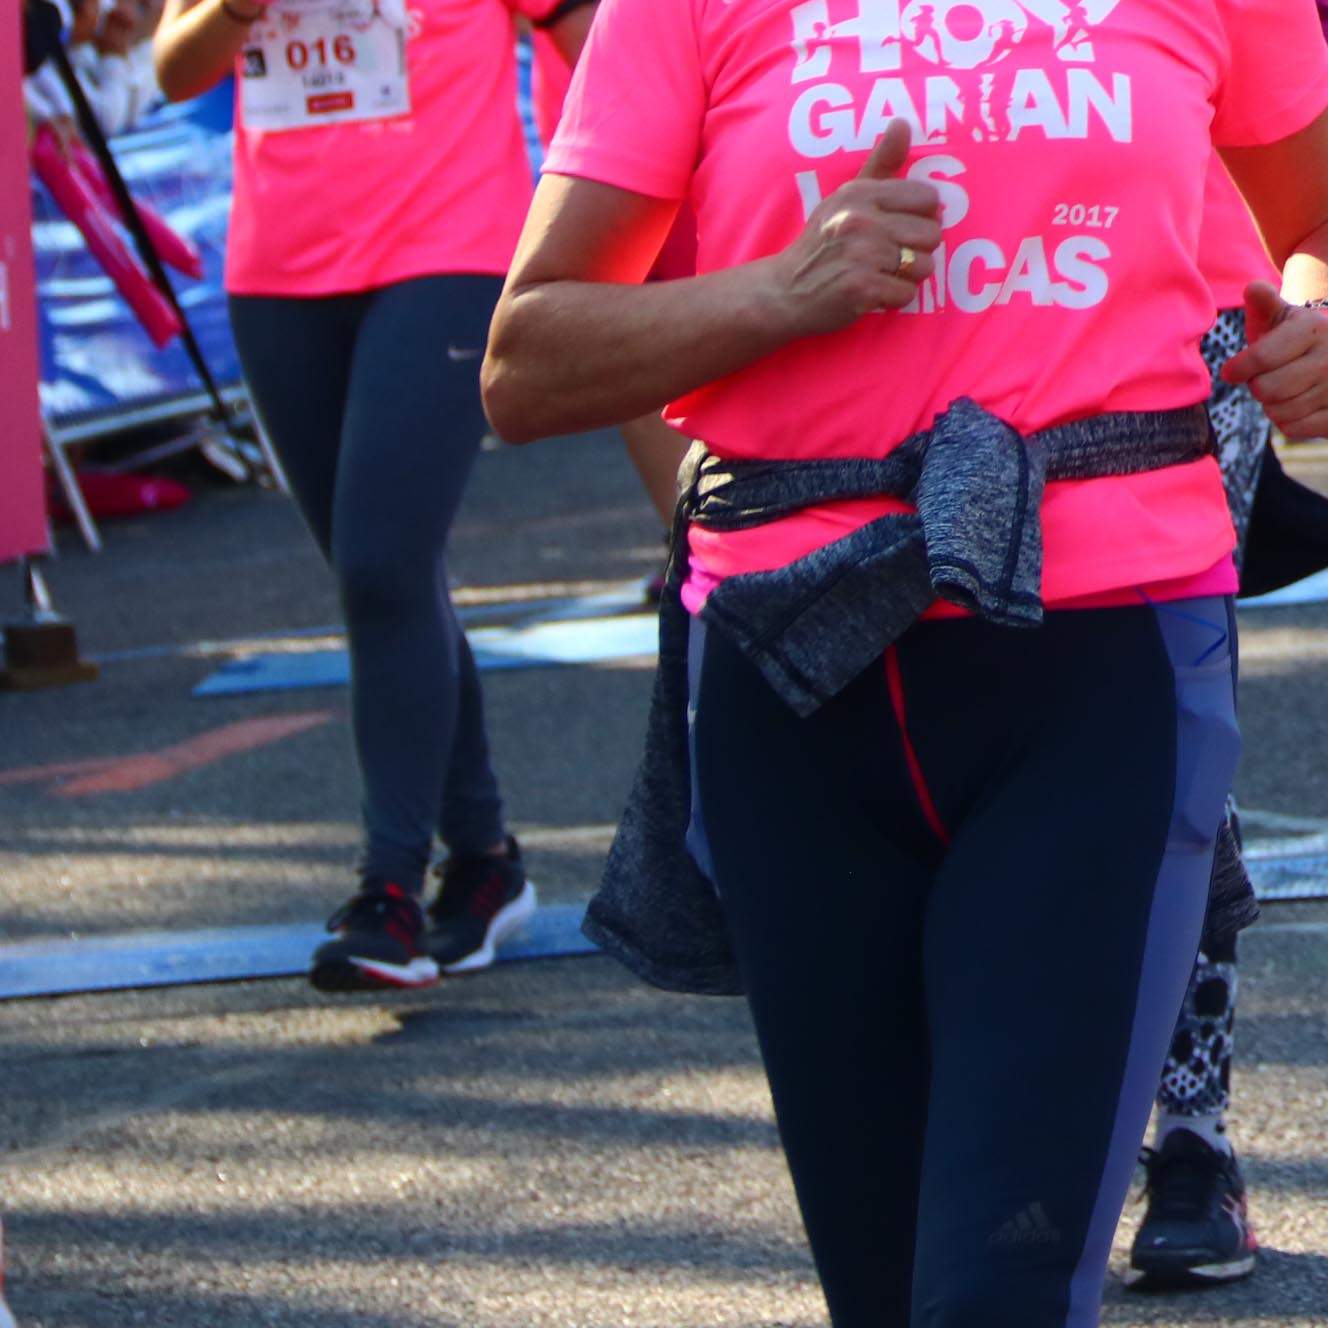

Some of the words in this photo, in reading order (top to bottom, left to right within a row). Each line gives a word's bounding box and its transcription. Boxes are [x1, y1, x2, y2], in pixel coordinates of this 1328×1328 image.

[286, 33, 357, 72] 016
[787, 68, 1133, 157] GANAN
[1052, 203, 1120, 229] 2017
